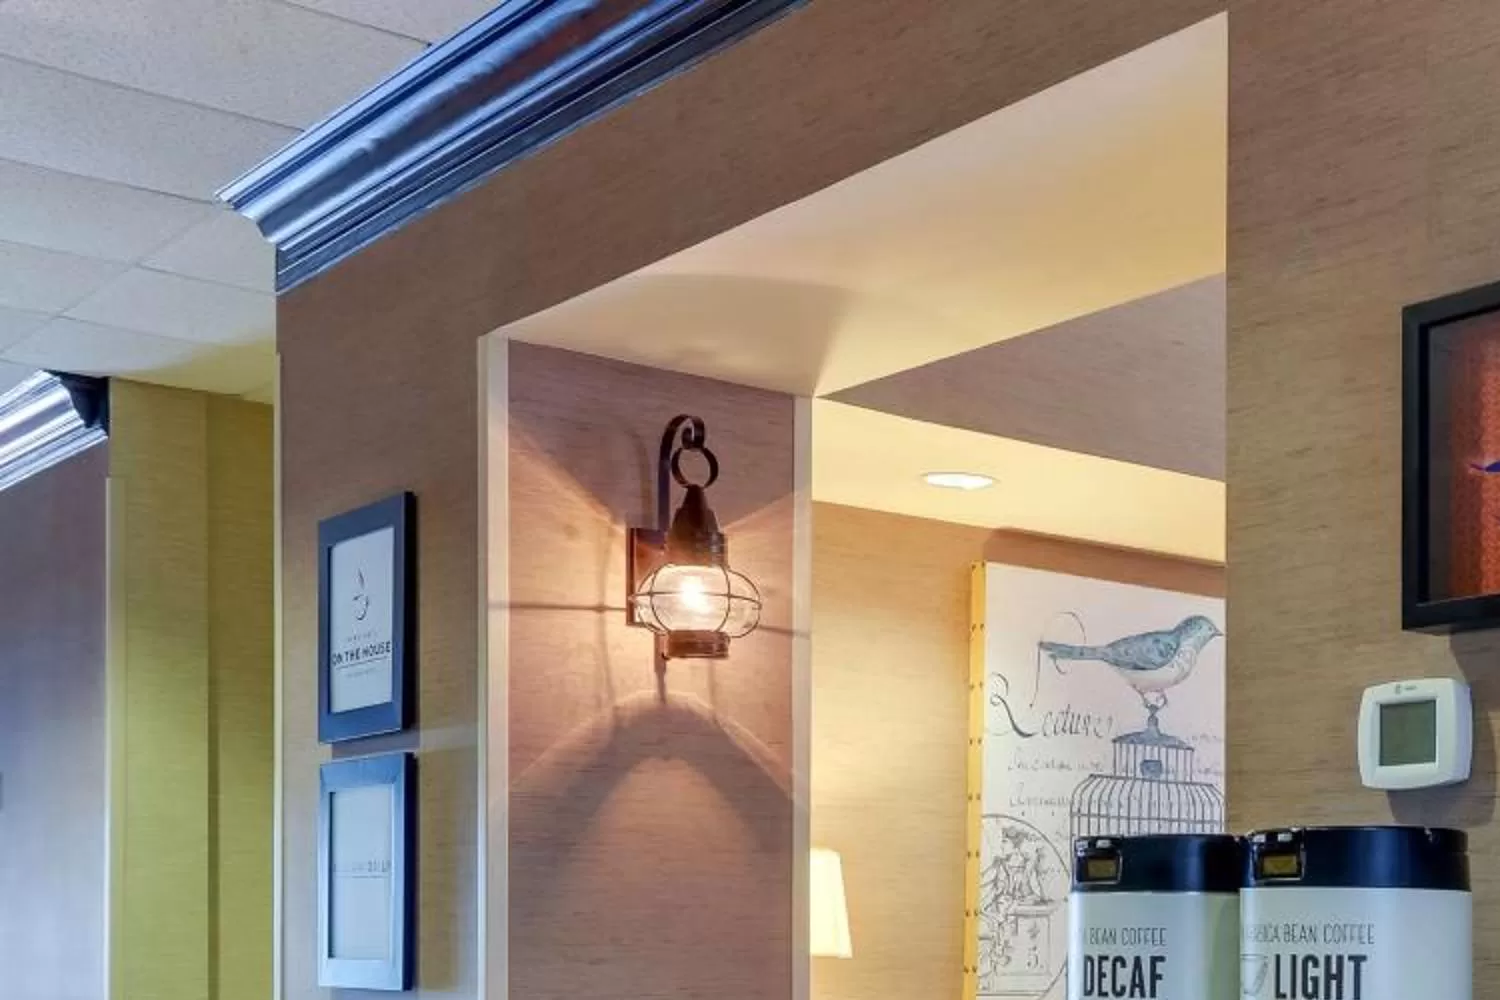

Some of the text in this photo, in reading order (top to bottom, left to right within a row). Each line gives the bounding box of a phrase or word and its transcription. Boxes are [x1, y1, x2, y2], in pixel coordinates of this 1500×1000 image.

[344, 647, 361, 663] THE
[363, 640, 391, 658] HOUSE
[1090, 927, 1168, 946] BEAN COFFEE
[1283, 923, 1318, 944] BEAN
[1323, 923, 1376, 945] COFFEE
[1083, 954, 1167, 999] DECAF
[1275, 953, 1368, 1000] LIGHT
